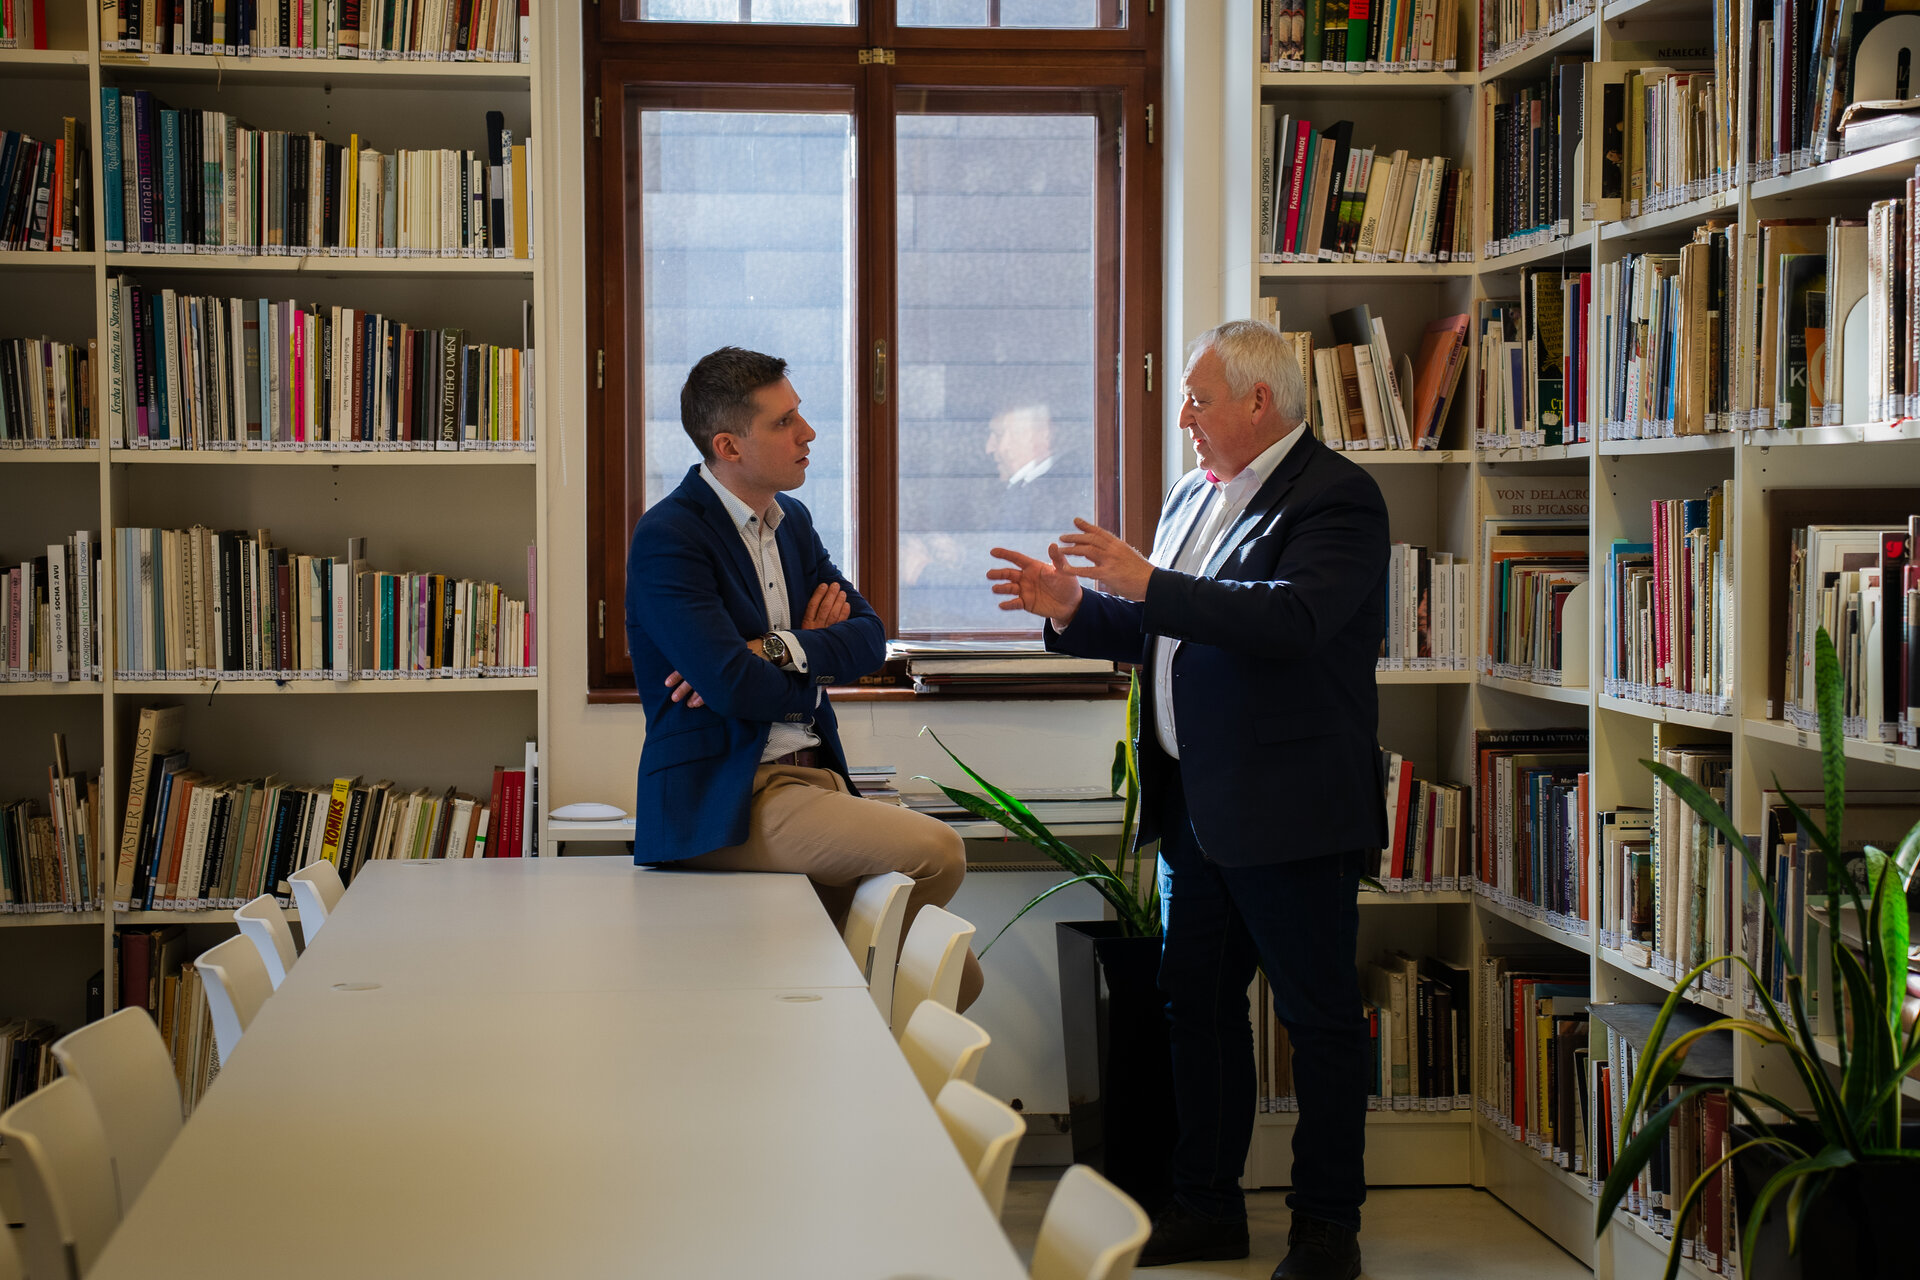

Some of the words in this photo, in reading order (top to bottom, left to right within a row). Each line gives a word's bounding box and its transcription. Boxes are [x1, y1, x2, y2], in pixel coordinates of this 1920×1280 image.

[1658, 46, 1708, 58] NĚMECKÉ
[166, 114, 174, 146] Kostüms
[140, 134, 150, 175] DESIGN
[1348, 154, 1357, 188] CHARLEMONT
[167, 162, 176, 204] Geschichte
[1290, 166, 1302, 210] FASZINATION
[1296, 136, 1306, 164] FREMDE
[1333, 172, 1342, 196] FORMAN
[1360, 155, 1370, 188] CHARLEMONT
[141, 178, 152, 222] dornach
[168, 207, 176, 226] Thiel
[1261, 196, 1270, 236] DRAWINGS
[1428, 194, 1437, 228] NAMALOVAT
[108, 288, 120, 328] Slovensku
[133, 290, 141, 328] KRESBY
[112, 330, 119, 341] na
[136, 332, 144, 370] MATISSE
[168, 326, 176, 372] NIZOZEMSKÉ
[444, 336, 456, 367] UMĚNÍ
[110, 346, 120, 374] storočia
[112, 388, 121, 414] Kresba
[444, 368, 456, 412] UŽITÉHO
[1496, 490, 1525, 500] VON
[1512, 504, 1532, 514] BIS
[1538, 504, 1589, 514] PICASSO
[128, 728, 152, 807] DRAWINGS
[324, 798, 344, 848] KOMIKS
[350, 794, 361, 826] DRAWINGS
[120, 810, 140, 868] MASTER
[346, 825, 356, 848] ITALIAN
[342, 848, 352, 870] NORTH
[92, 988, 98, 996] R
